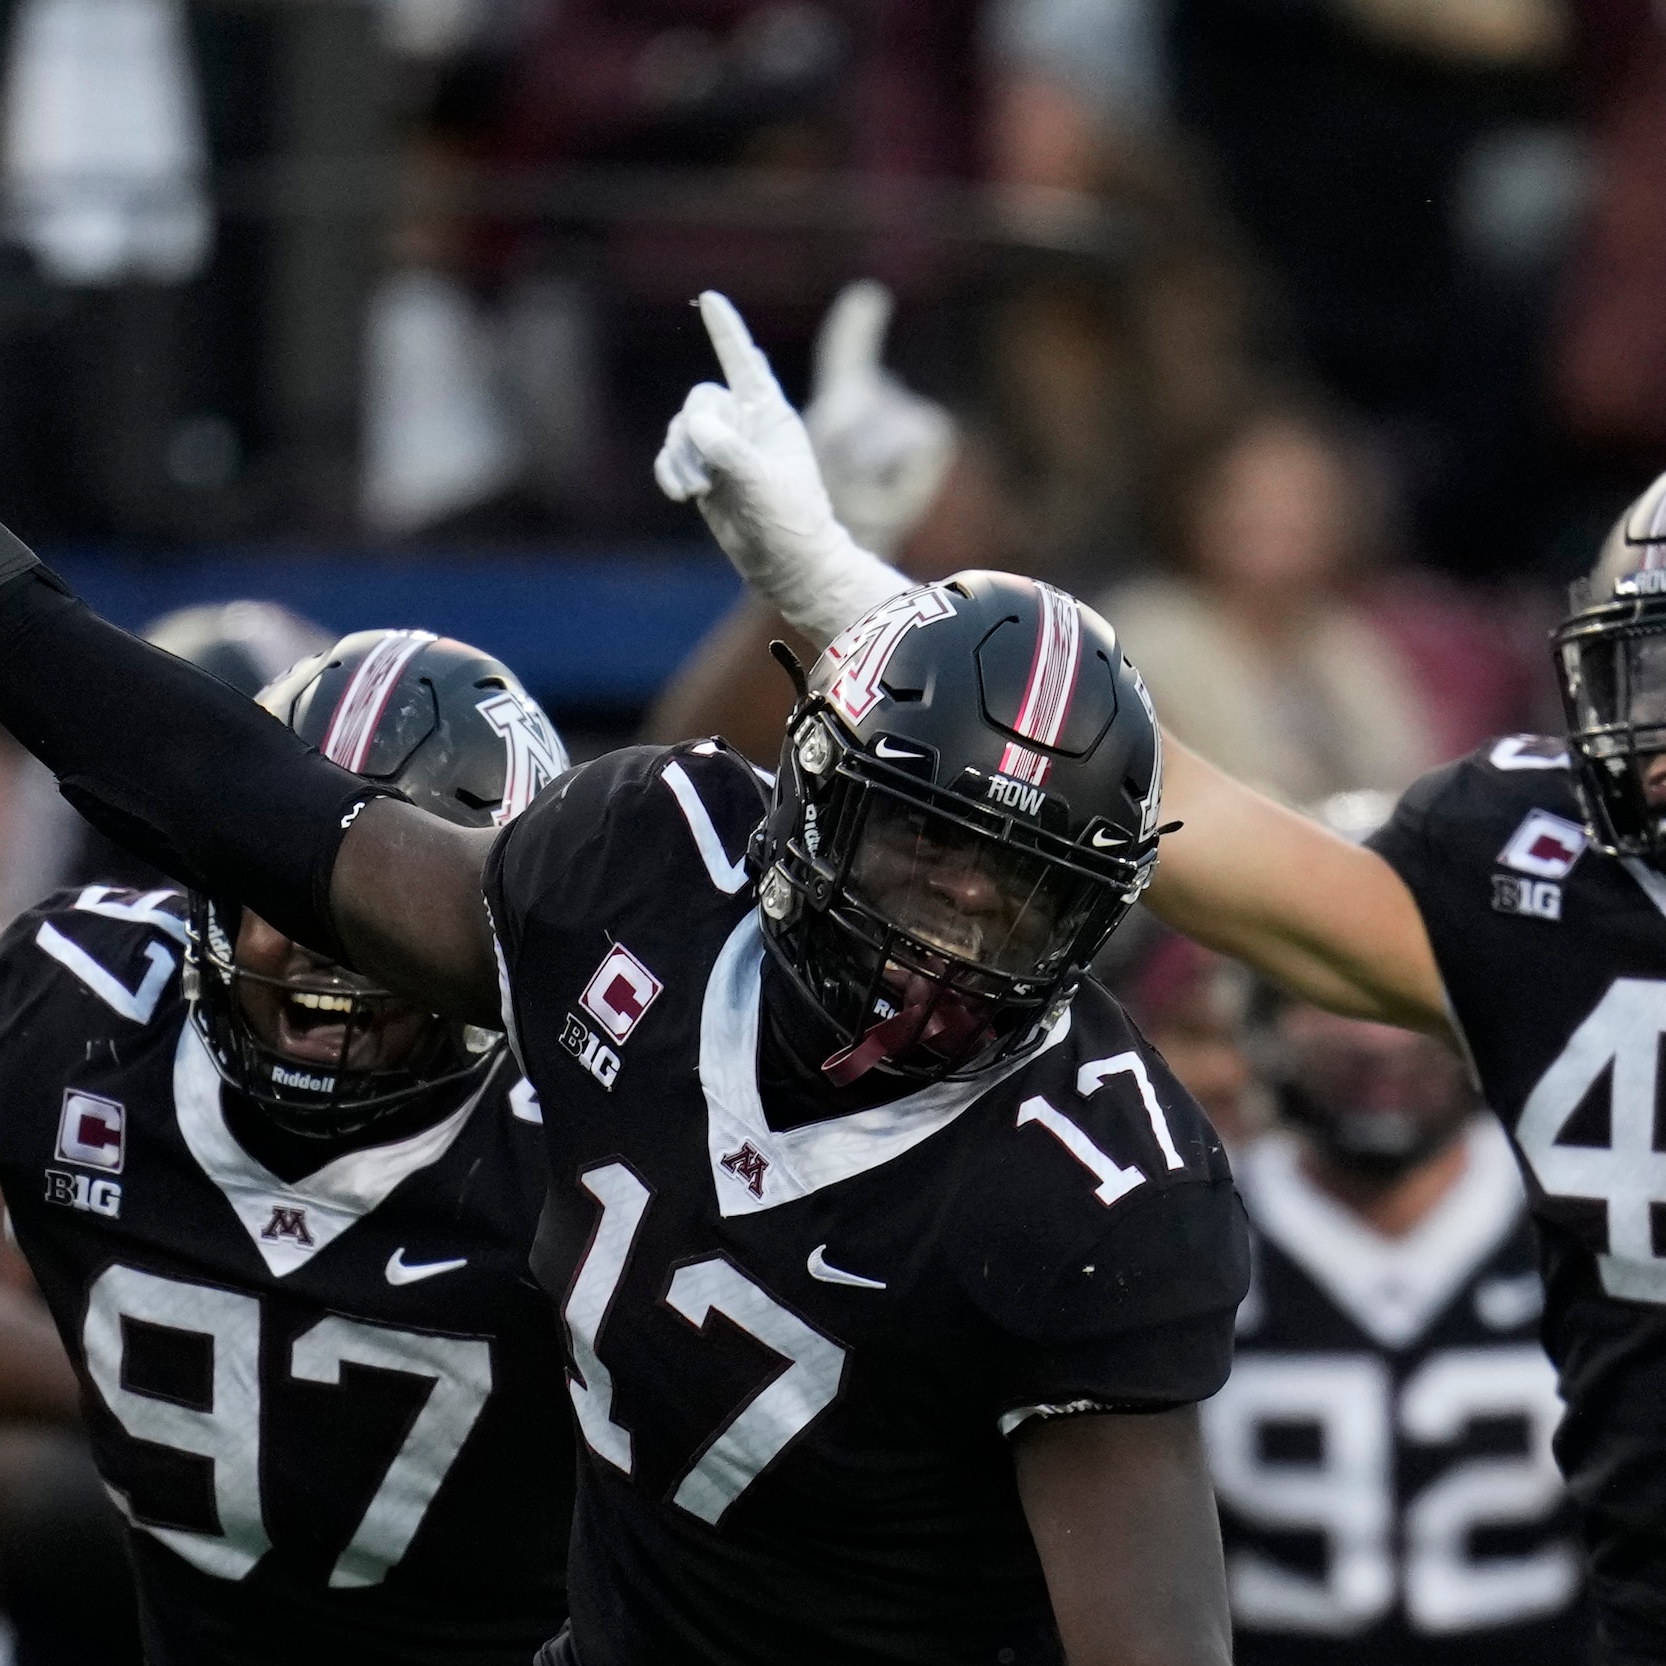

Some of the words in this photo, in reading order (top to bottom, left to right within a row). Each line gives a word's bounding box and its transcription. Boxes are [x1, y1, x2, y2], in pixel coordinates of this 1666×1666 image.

[987, 778, 1047, 816] ROW
[271, 1065, 336, 1093] Riddell
[1016, 1050, 1185, 1207] 17
[721, 1140, 770, 1201] M
[259, 1204, 316, 1249] M
[564, 1160, 848, 1527] 17
[82, 1263, 494, 1589] 97
[1197, 1350, 1585, 1637] 92
